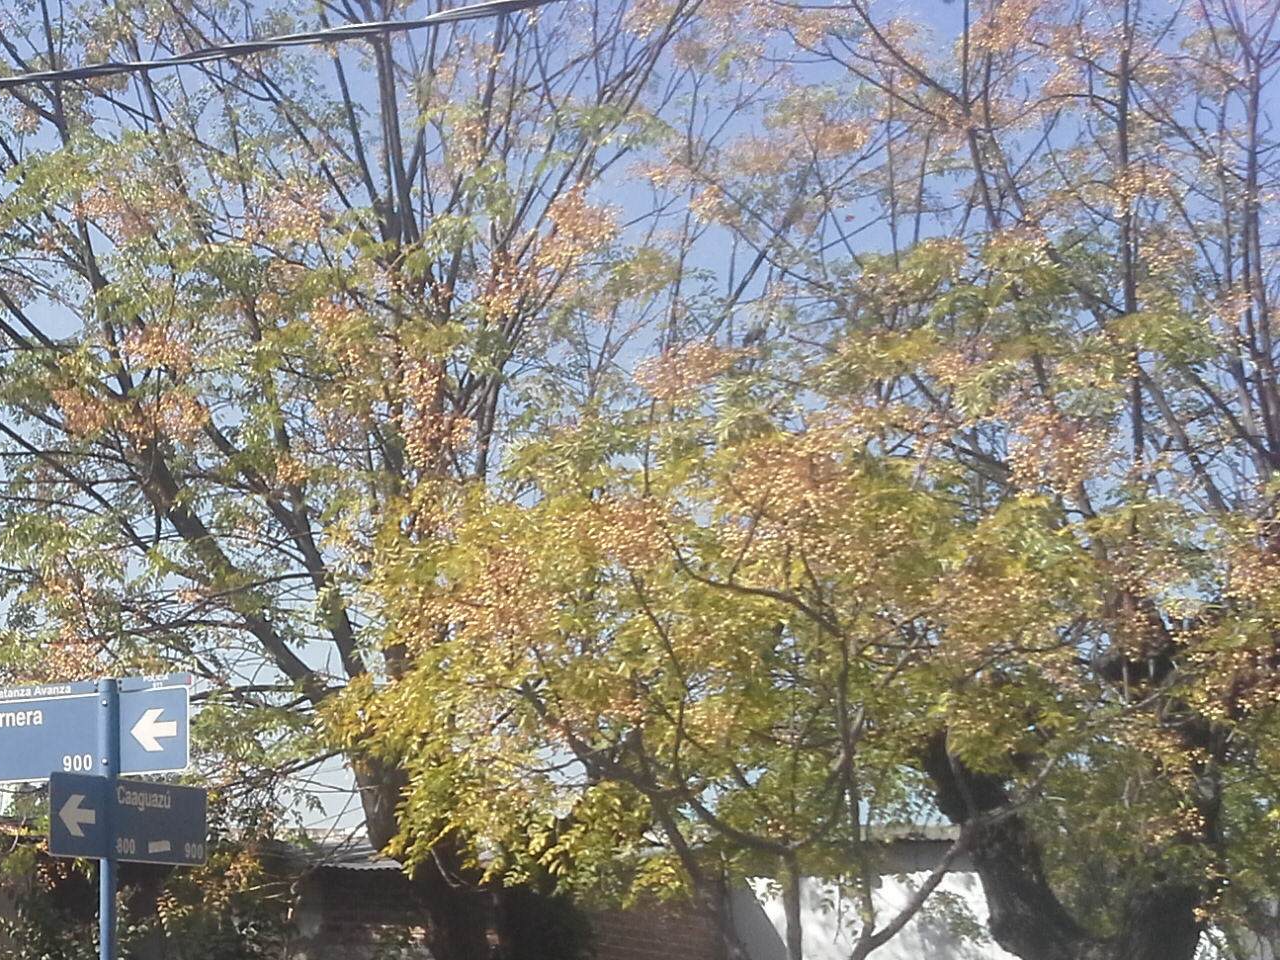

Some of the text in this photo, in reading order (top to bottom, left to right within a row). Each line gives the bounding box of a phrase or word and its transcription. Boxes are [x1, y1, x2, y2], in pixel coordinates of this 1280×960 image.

[33, 685, 71, 696] Avanza
[63, 754, 93, 772] 900
[117, 785, 171, 811] Caaguazú
[184, 843, 203, 859] 900
